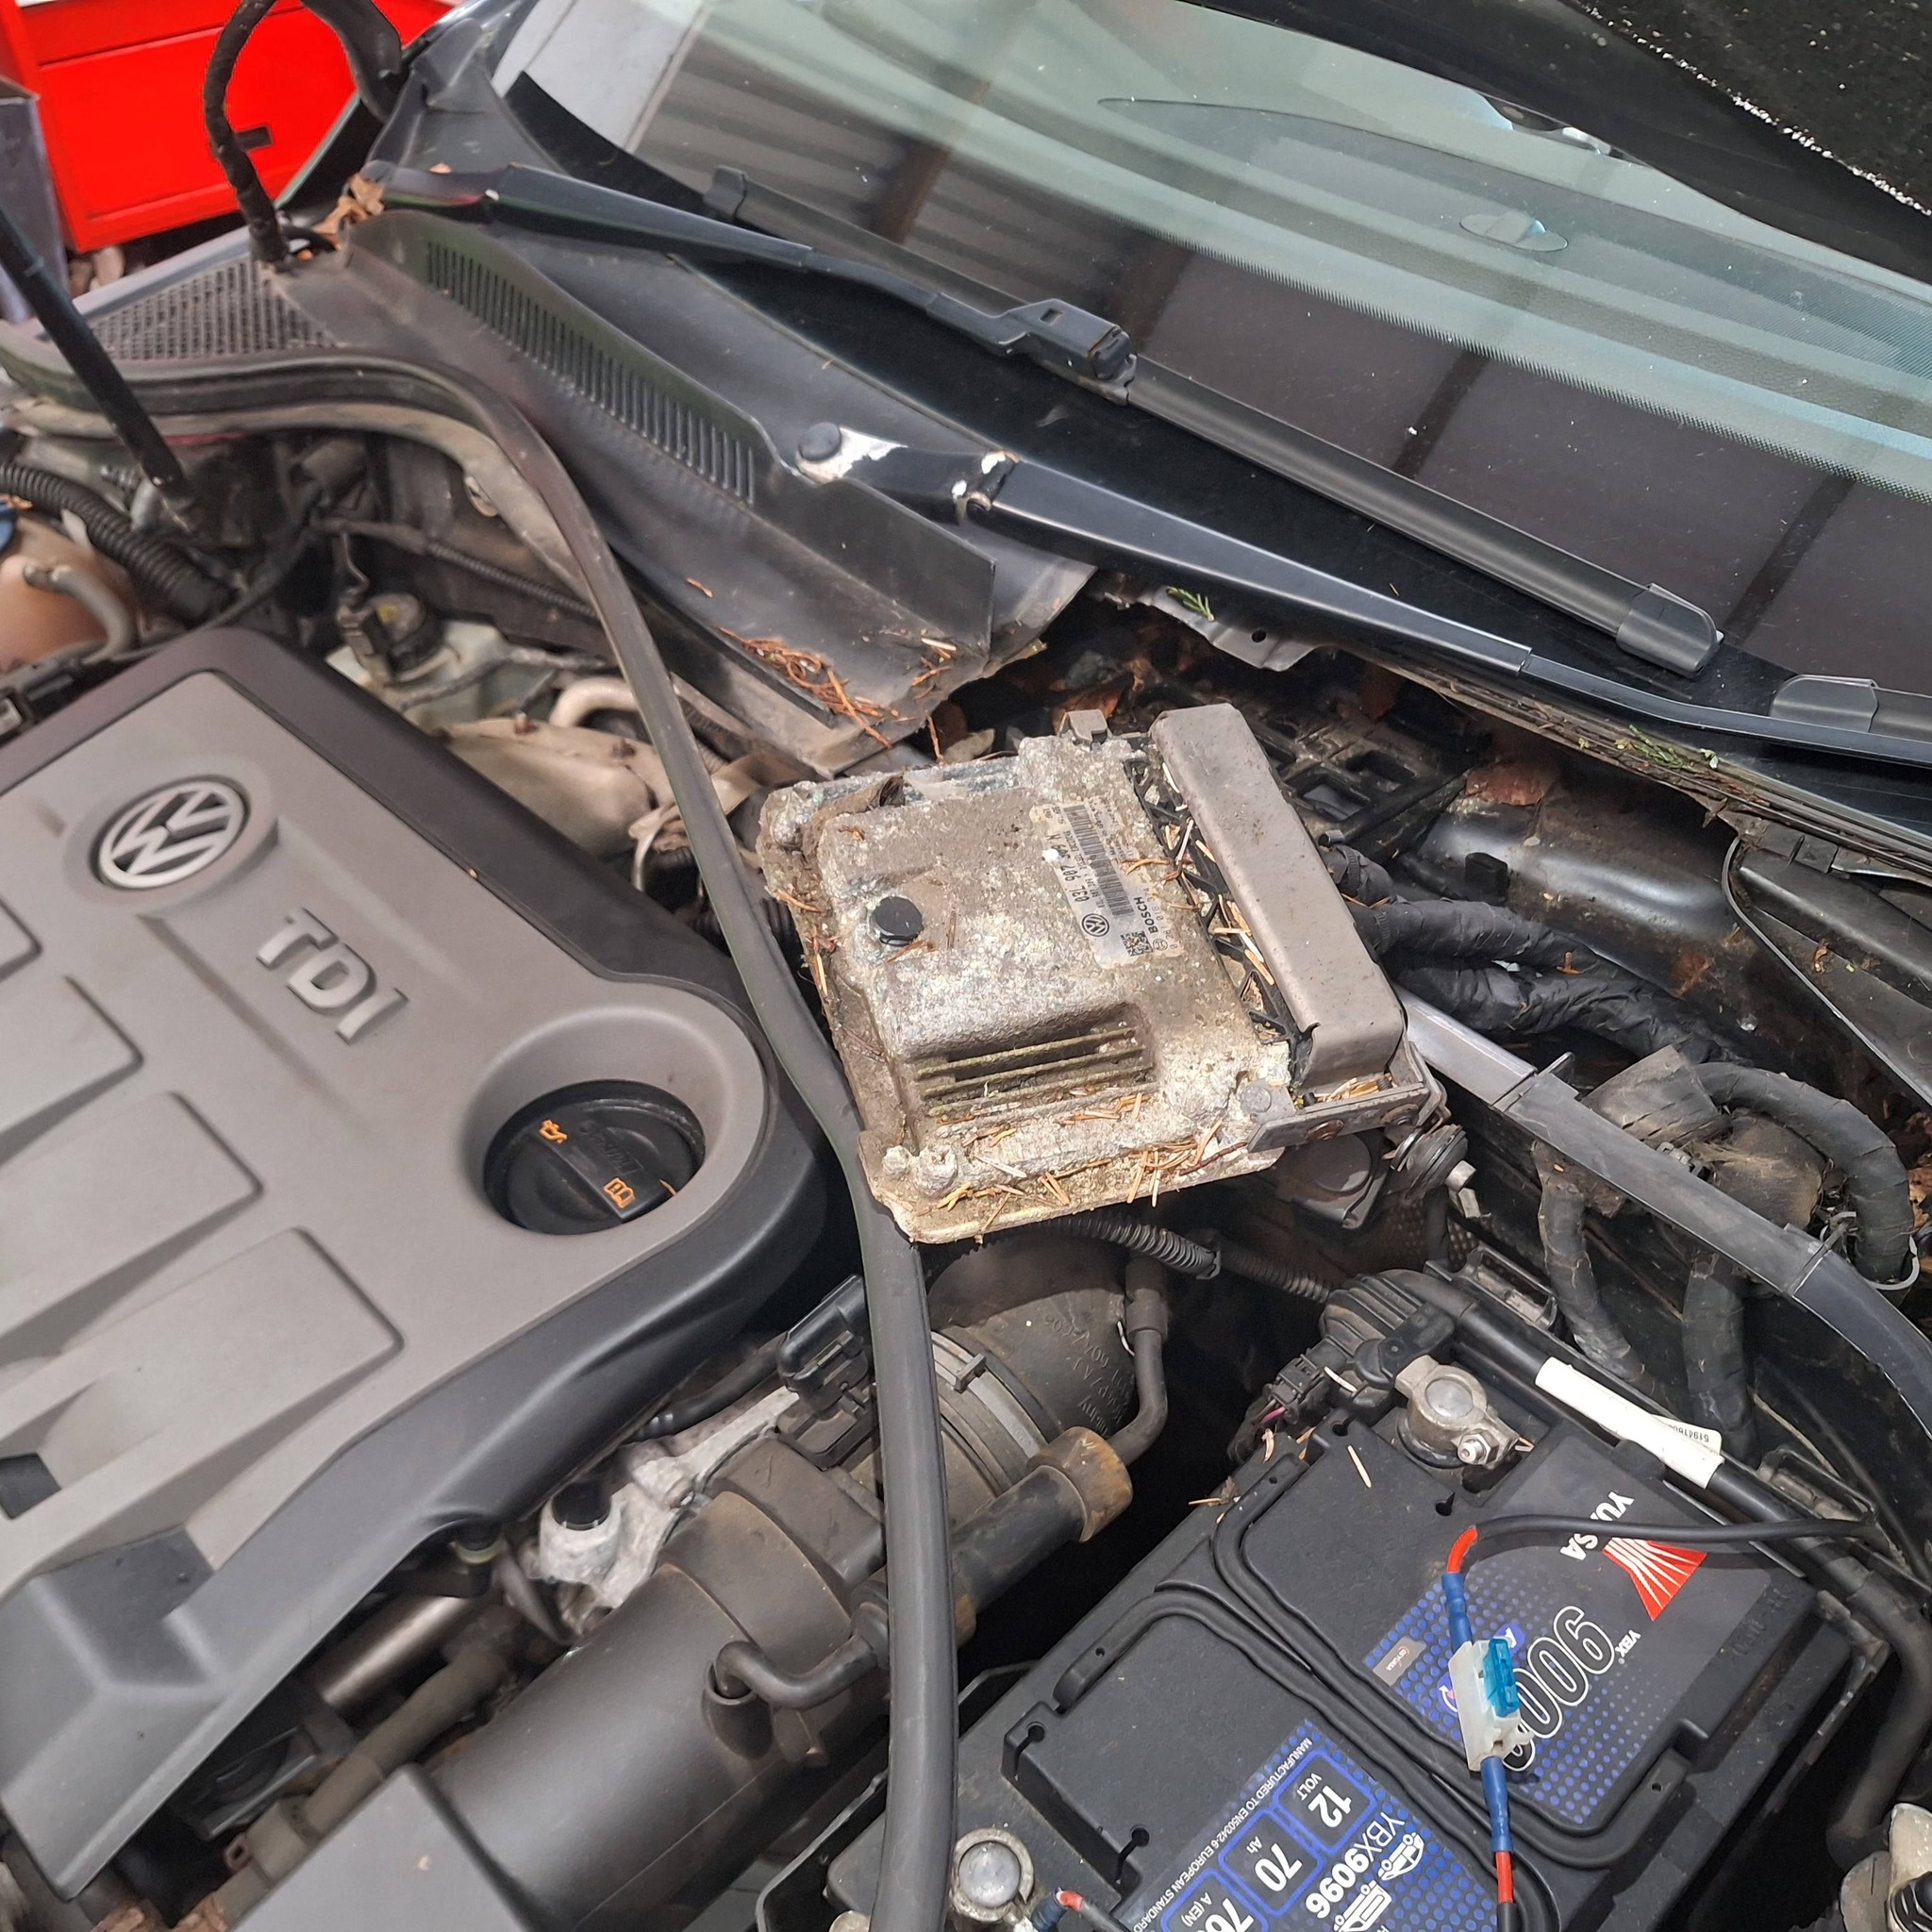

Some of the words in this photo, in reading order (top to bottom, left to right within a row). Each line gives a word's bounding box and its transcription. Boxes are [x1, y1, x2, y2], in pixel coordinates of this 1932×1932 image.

[1060, 864, 1081, 882] 907
[1133, 896, 1158, 934] BOSCH
[257, 908, 408, 1045] TDI
[1256, 1738, 1312, 1801] MANUFACTURED
[1297, 1773, 1323, 1801] VOLT
[1246, 1799, 1259, 1811] TO
[1308, 1785, 1353, 1828] 12
[1211, 1807, 1249, 1848] EN50342-6
[1246, 1836, 1262, 1854] Ah
[1172, 1846, 1214, 1893] EUROPEAN
[1255, 1843, 1303, 1892] 70
[1306, 1812, 1405, 1918] YBX9096
[1133, 1890, 1175, 1932] STANDARD
[1181, 1901, 1205, 1926] (EN)
[1197, 1898, 1254, 1932] 76
[1200, 1892, 1212, 1906] A
